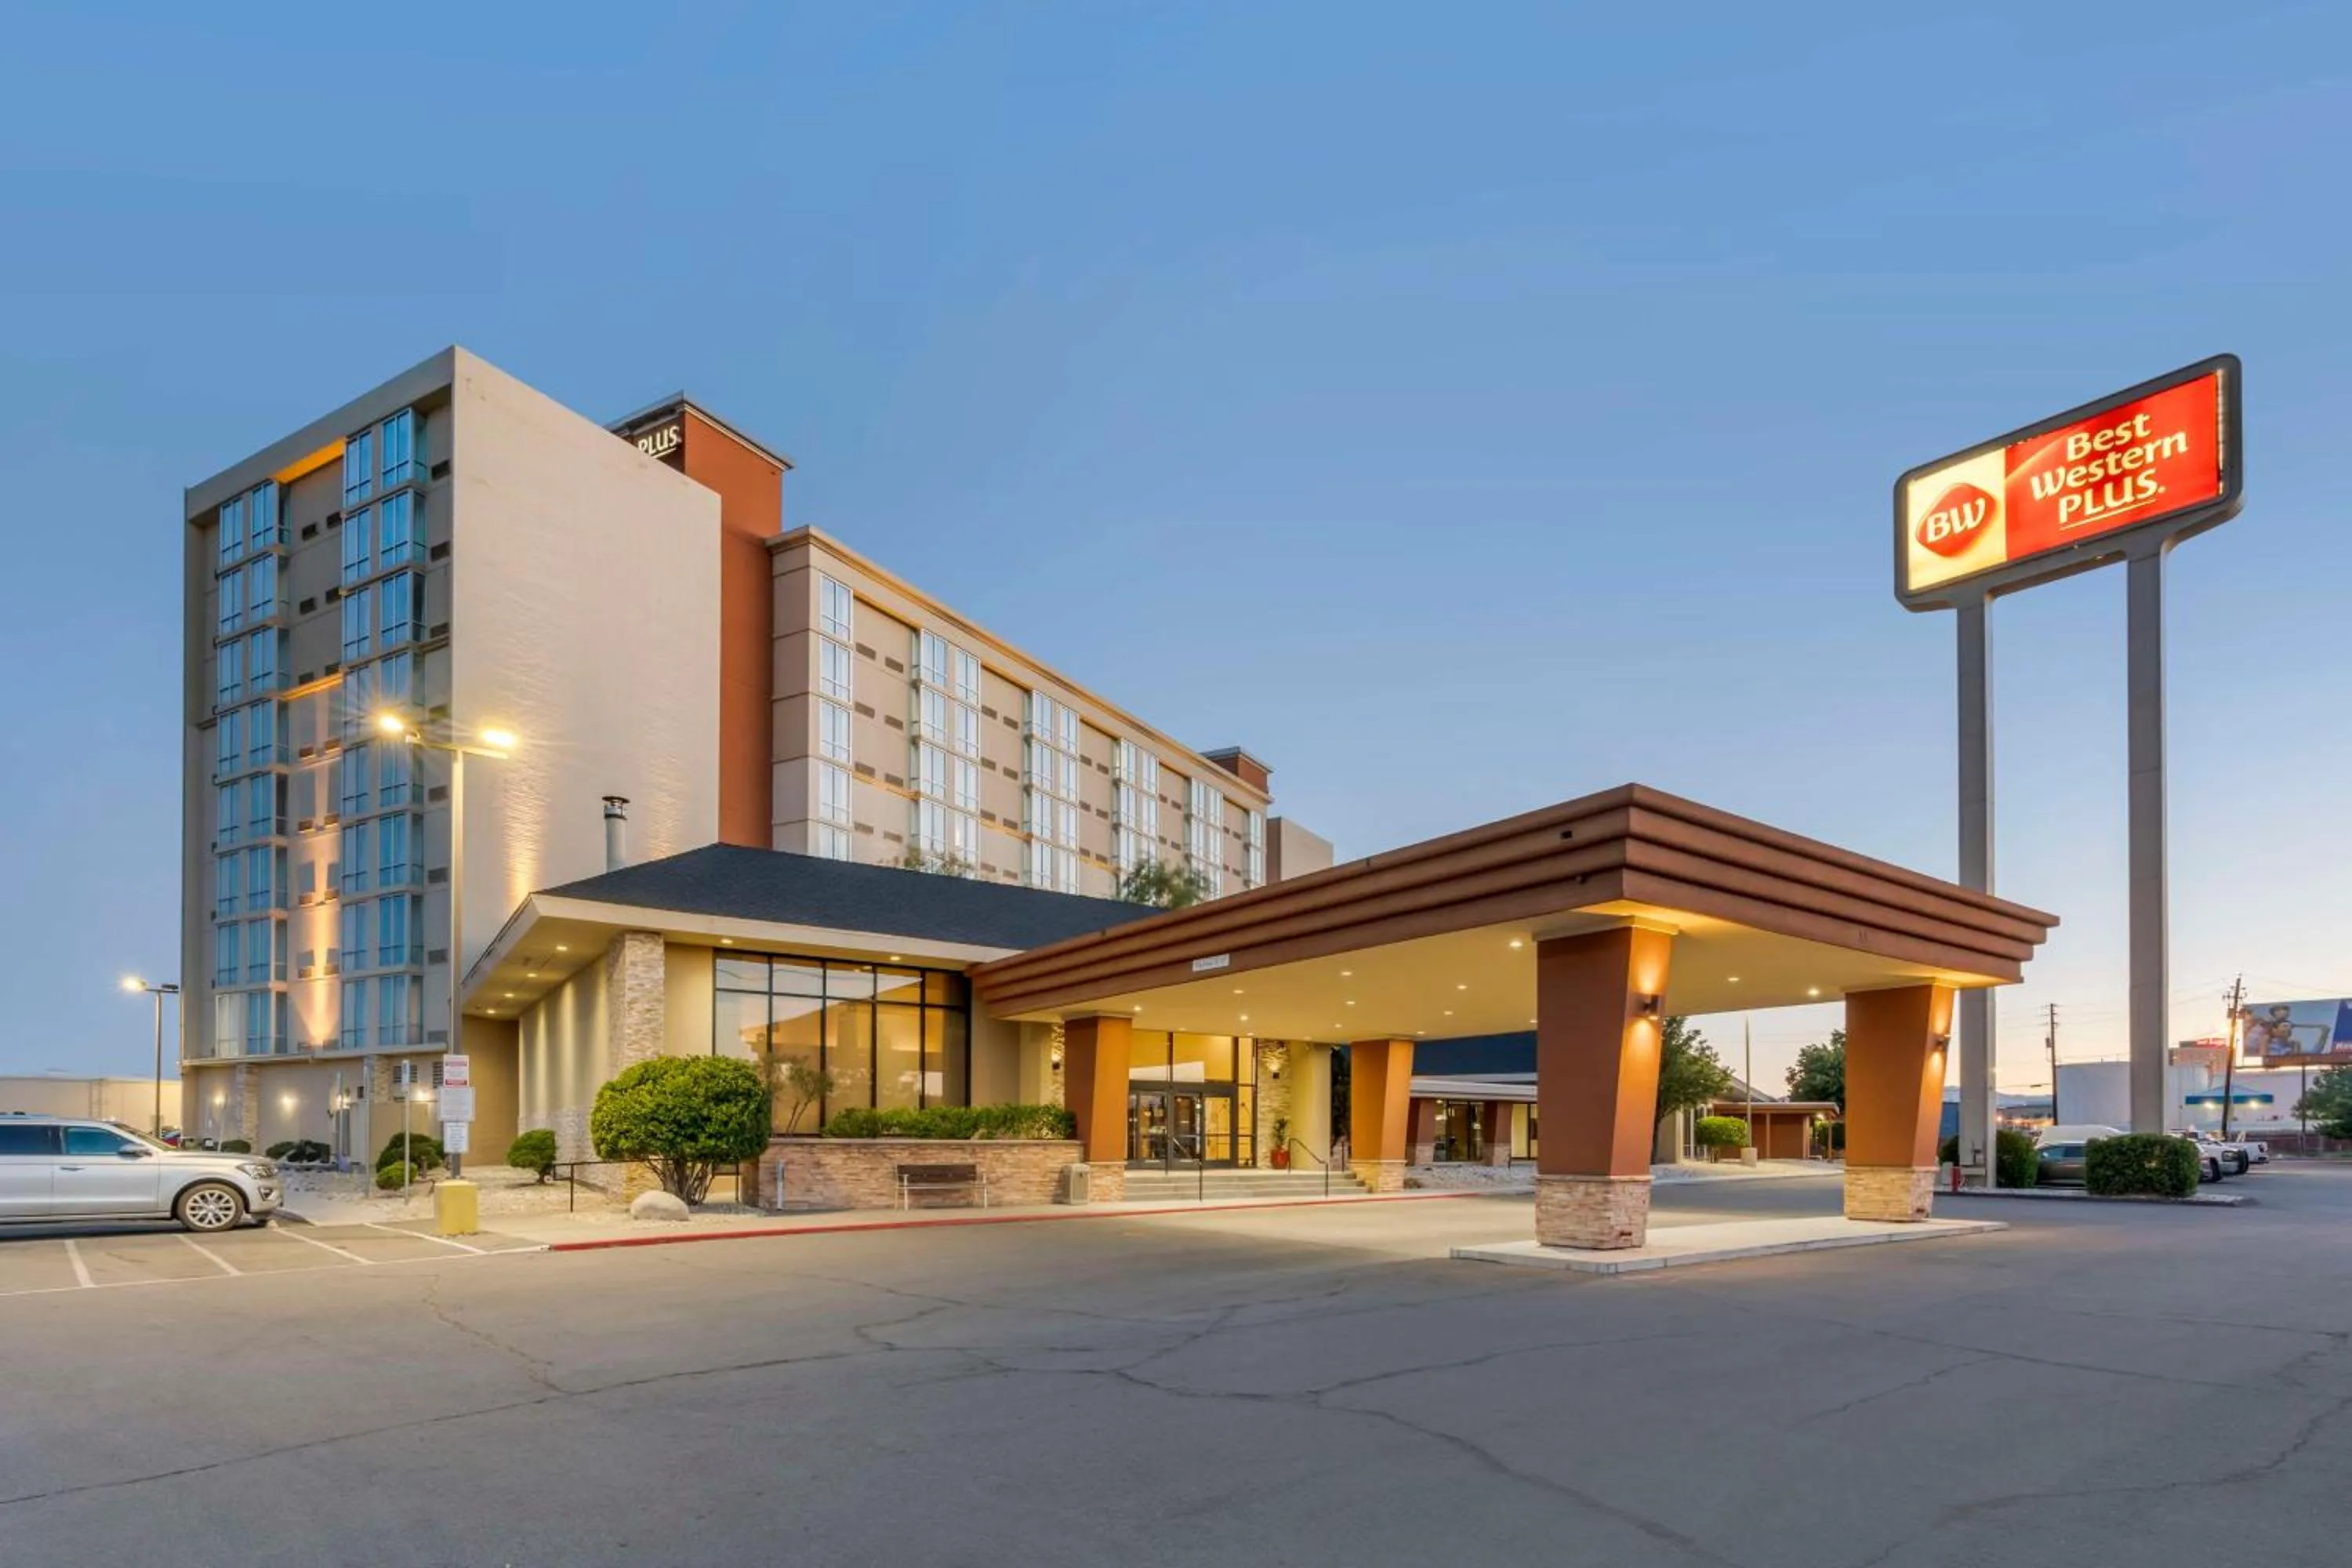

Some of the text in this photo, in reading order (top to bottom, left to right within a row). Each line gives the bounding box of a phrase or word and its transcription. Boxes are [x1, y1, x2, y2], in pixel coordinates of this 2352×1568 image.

[2066, 413, 2151, 462] Best
[2030, 431, 2188, 501] Western
[1926, 497, 1986, 543] BW
